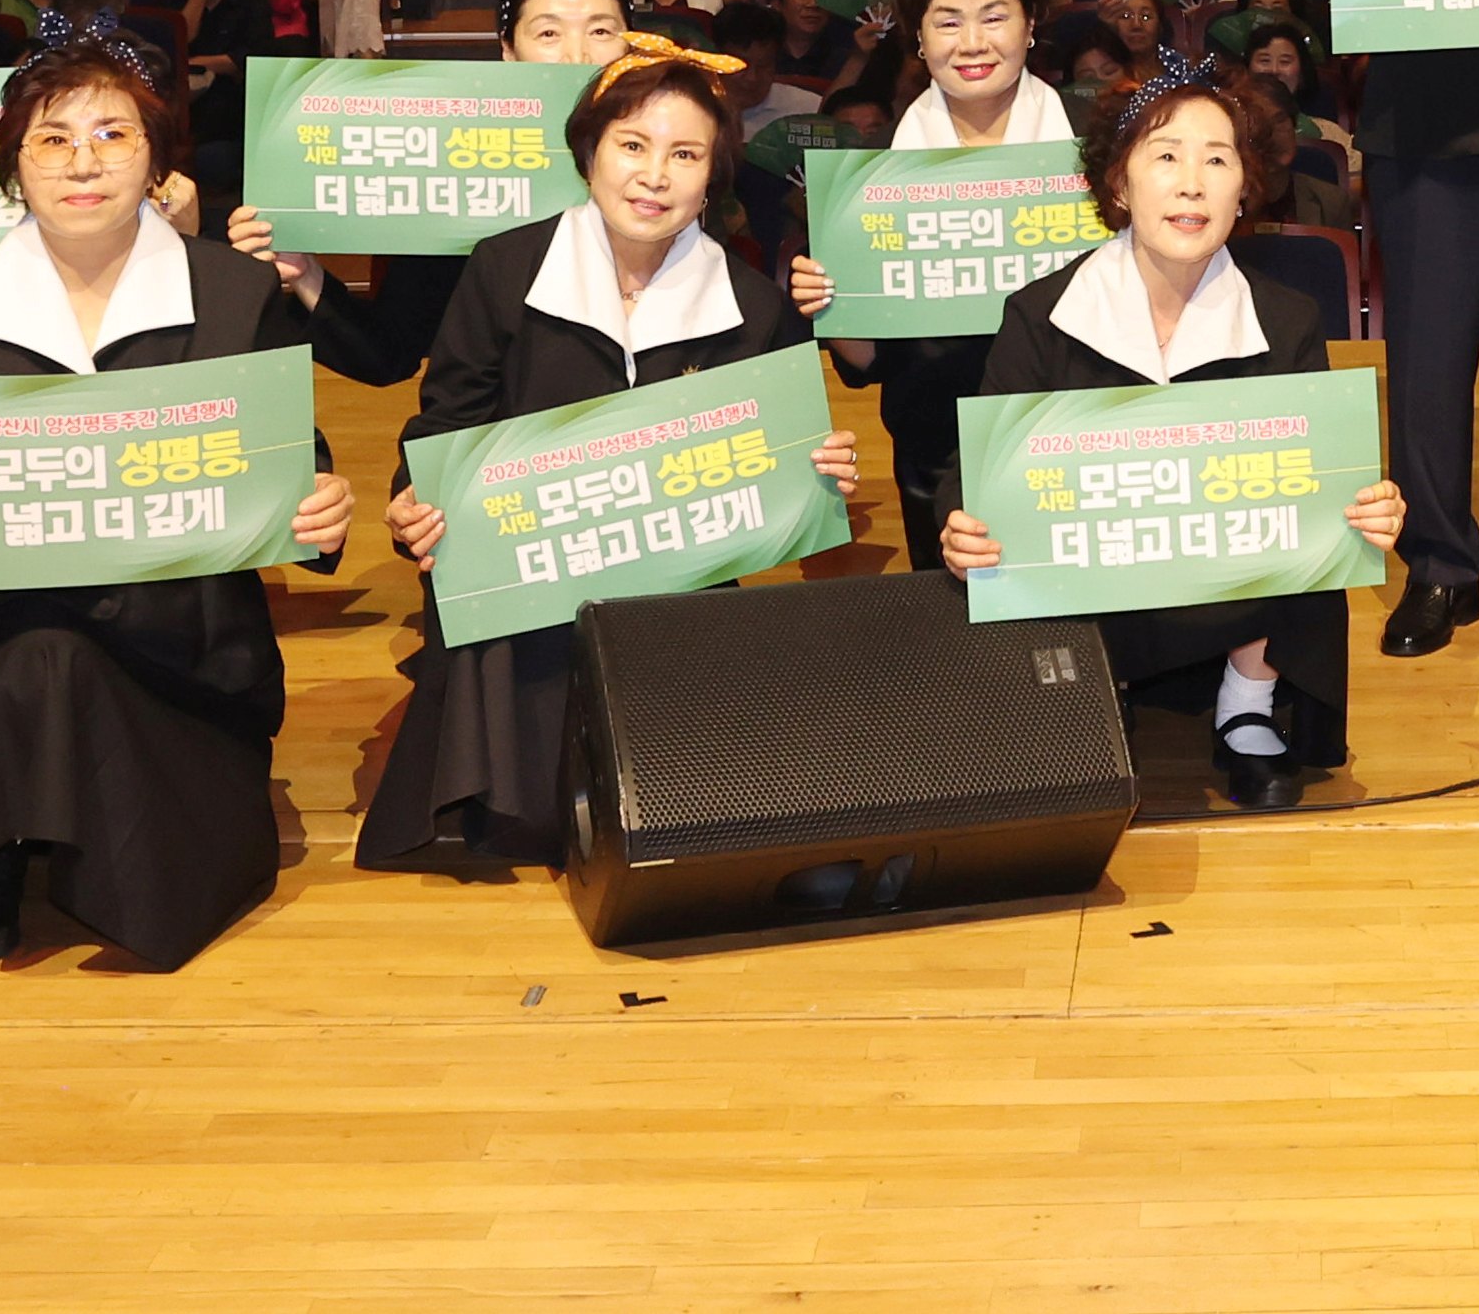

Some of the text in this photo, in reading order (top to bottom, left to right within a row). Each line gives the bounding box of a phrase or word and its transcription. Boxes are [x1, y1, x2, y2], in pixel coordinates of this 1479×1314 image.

[342, 125, 552, 170] 모두의 성평등,
[314, 174, 532, 218] 더 넓고 더 깊게
[907, 207, 1004, 250] 모두의
[881, 255, 1027, 299] 더 넓고 더
[44, 409, 158, 435] 양성평등주간
[164, 399, 237, 424] 기념행사
[483, 400, 757, 484] 2026 양산시 양성평등주간 기념행사
[1029, 416, 1308, 455] 2026 양산시 양성평등주간 기념행사
[116, 429, 251, 488] 성평등,
[536, 428, 778, 528] 모두의 성평등,
[1079, 447, 1321, 510] 모두의 성평등,
[3, 500, 86, 547] 넓고
[93, 497, 135, 541] 더
[143, 486, 227, 538] 깊게
[516, 485, 766, 585] 더 넓고 더 깊게
[1051, 505, 1300, 568] 더 넓고 더 깊게
